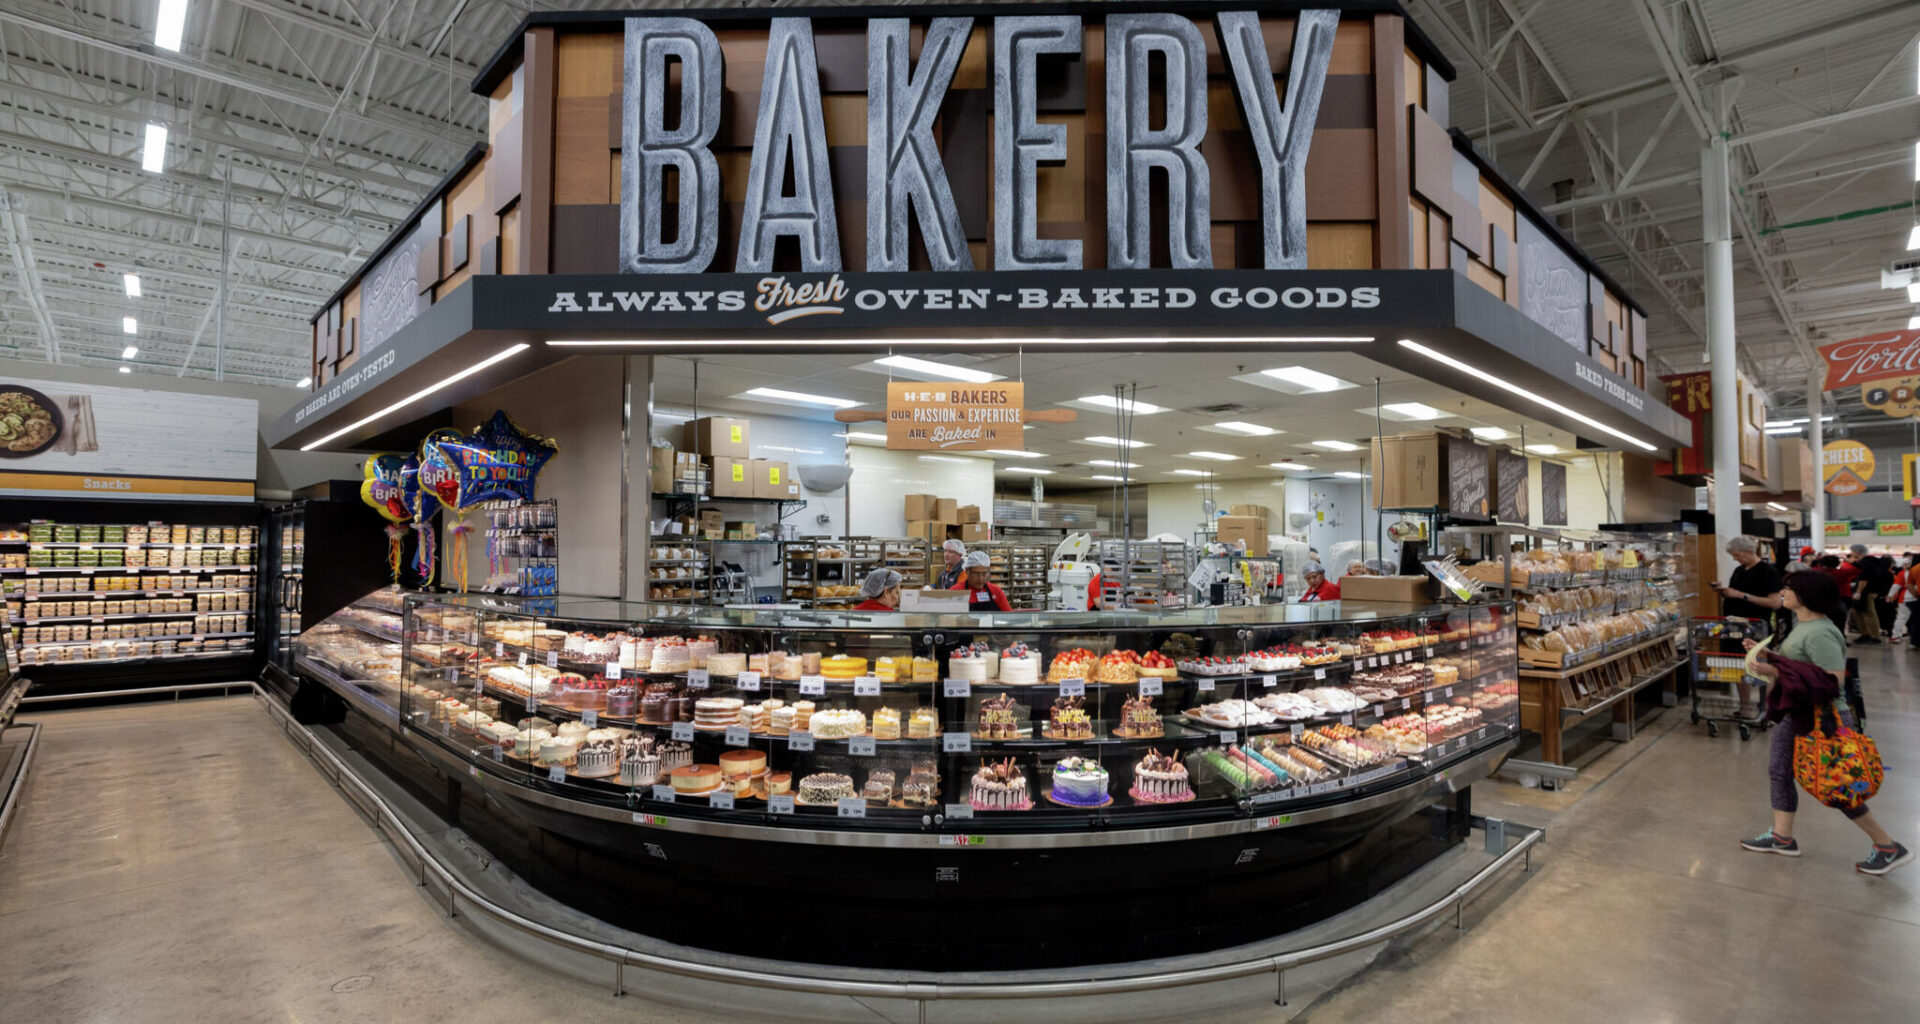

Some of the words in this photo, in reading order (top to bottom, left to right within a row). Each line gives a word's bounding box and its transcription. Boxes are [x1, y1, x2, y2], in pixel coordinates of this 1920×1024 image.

[619, 9, 1341, 273] BAKERY
[547, 290, 746, 313] ALWAYS
[755, 274, 849, 312] Fresh
[1210, 287, 1381, 310] GOODS
[1575, 361, 1603, 389] BAKED
[1603, 378, 1627, 401] FRESH
[1626, 391, 1644, 411] DAILY
[295, 408, 306, 424] OUR
[305, 394, 328, 416] BAKERS
[327, 385, 341, 403] ARE
[951, 390, 1008, 404] BAKERS
[891, 410, 911, 420] OUR
[913, 408, 956, 423] PASSION
[958, 411, 965, 420] &
[967, 408, 1021, 423] EXPERTISE
[908, 429, 927, 439] ARE
[929, 425, 983, 443] Baked
[985, 429, 996, 440] IN
[1823, 449, 1865, 465] CHEESE
[468, 465, 488, 480] TO
[490, 466, 530, 481] YOU!!!
[83, 478, 131, 491] Snacks
